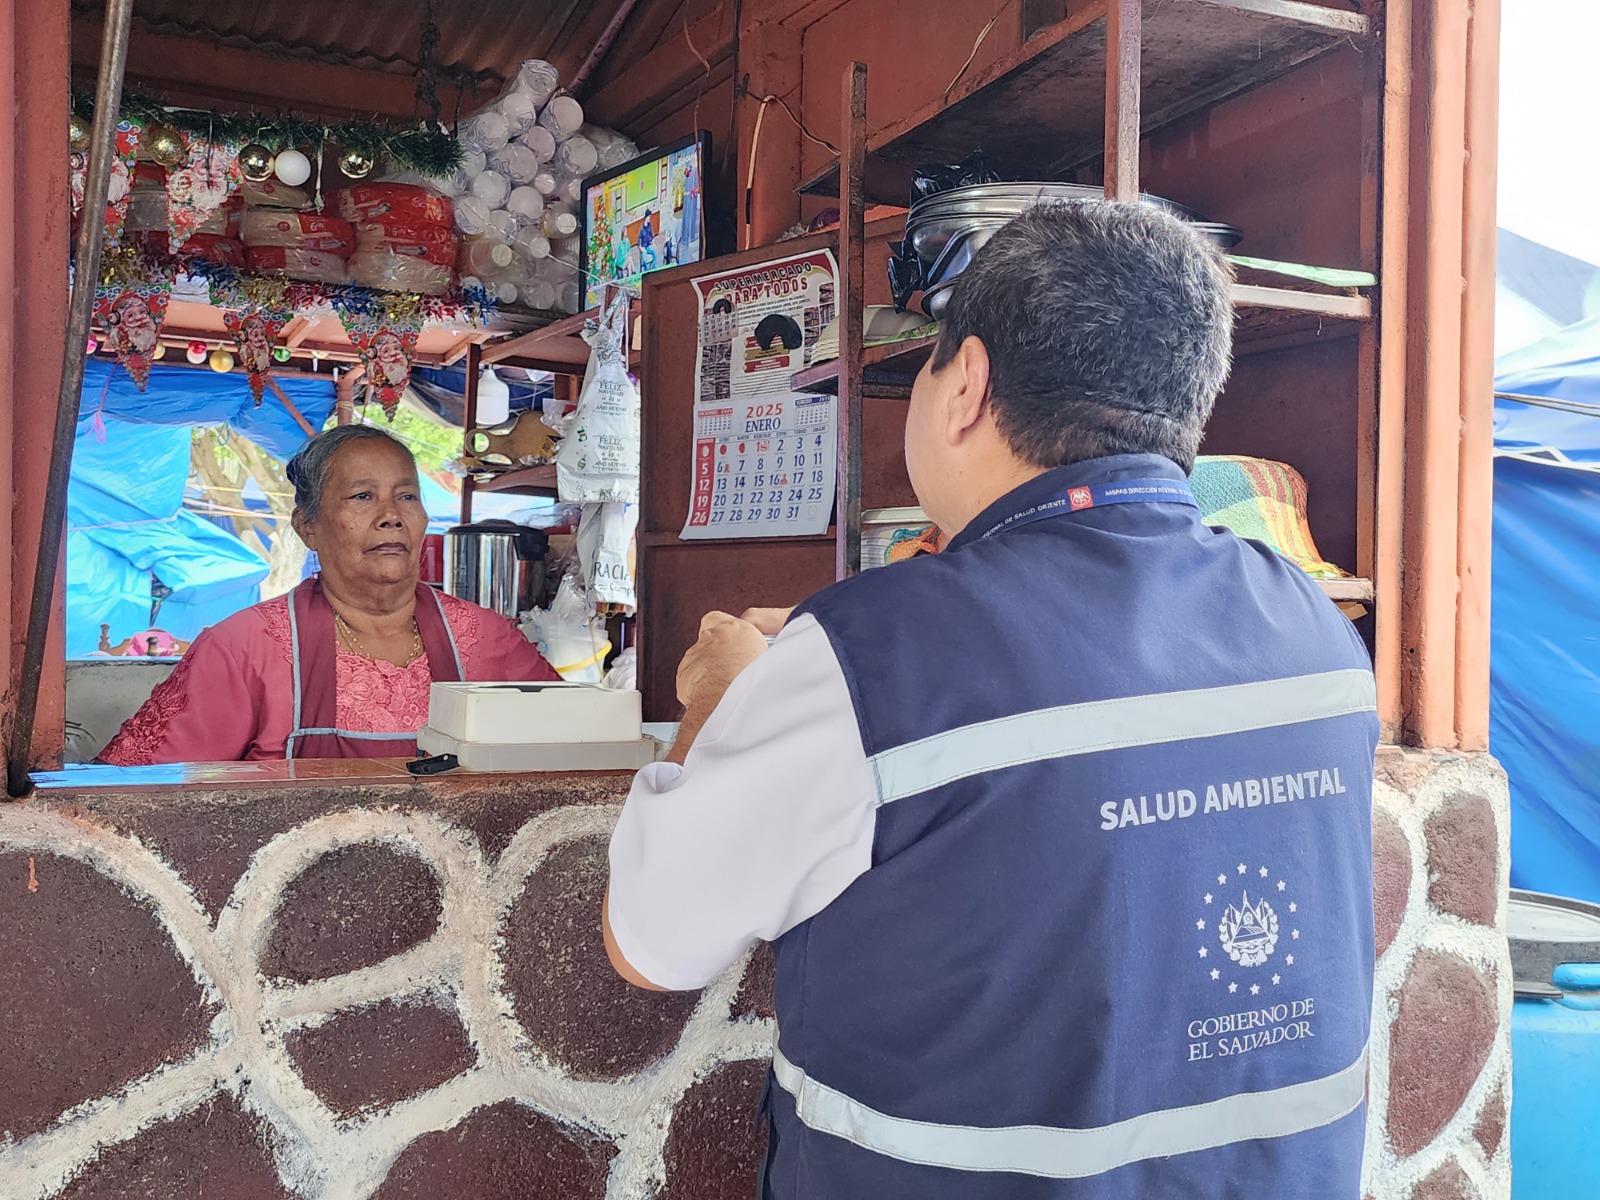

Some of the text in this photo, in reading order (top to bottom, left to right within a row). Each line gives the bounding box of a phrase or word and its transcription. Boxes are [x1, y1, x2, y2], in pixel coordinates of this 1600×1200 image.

[714, 262, 812, 292] SUPERMERCADO
[724, 286, 759, 305] PARA
[764, 277, 808, 298] TODOS
[599, 382, 622, 391] FELIZ
[746, 402, 784, 419] 2025
[745, 417, 781, 433] ENERO
[599, 437, 622, 445] FELIZ
[777, 439, 784, 451] 2
[796, 437, 803, 449] 3
[814, 434, 822, 447] 4
[701, 452, 822, 475] 5 6 7 8 9 10 11
[699, 470, 823, 491] 12 13 14 15 16 17 18
[697, 487, 823, 508] 19 20 21 22 23 24 25
[693, 505, 799, 523] 26 27 28 29 30 31
[1013, 507, 1036, 520] SALUD
[1037, 498, 1066, 511] ORIENTE
[1099, 767, 1346, 831] SALUD AMBIENTAL
[1187, 998, 1315, 1038] GOBIERNO DE
[1187, 1021, 1316, 1062] EL SALVADOR
